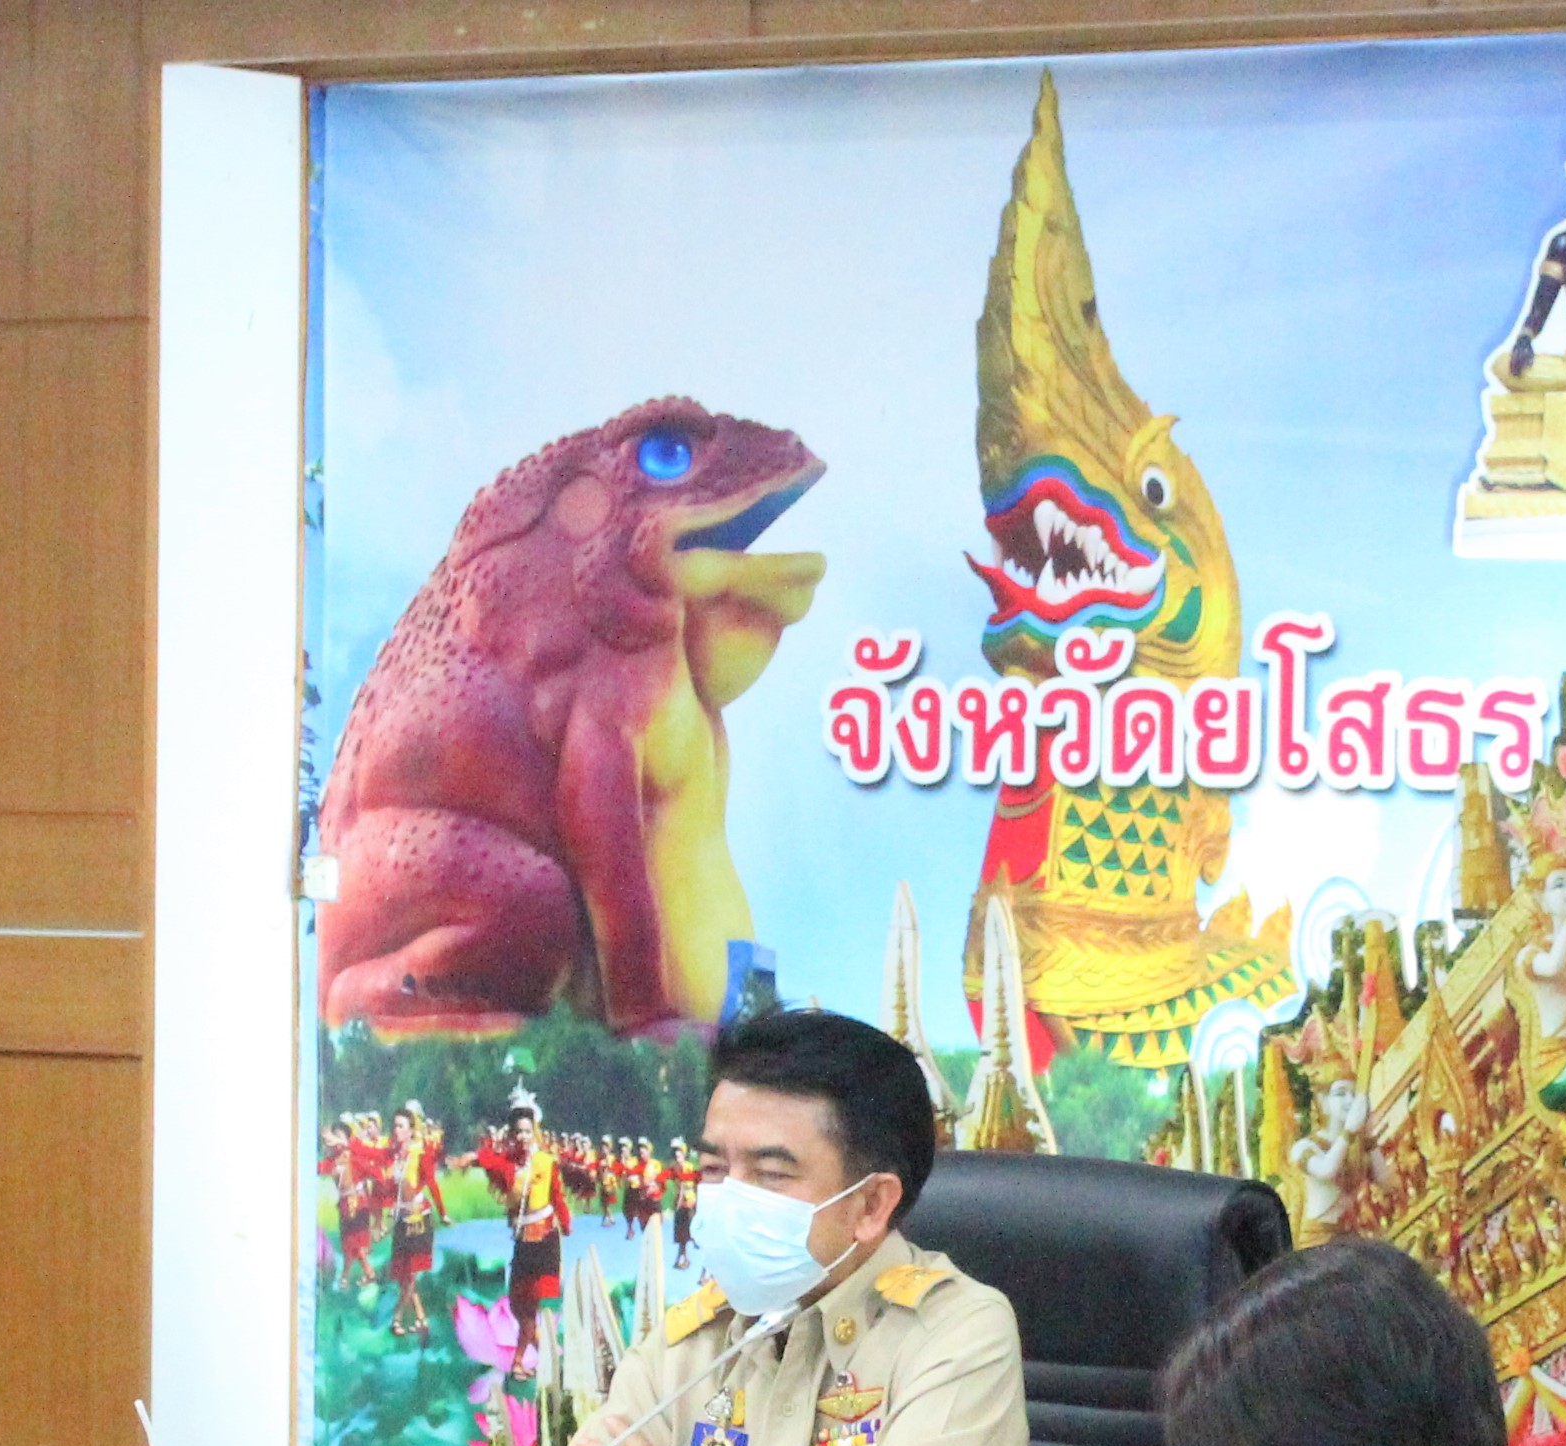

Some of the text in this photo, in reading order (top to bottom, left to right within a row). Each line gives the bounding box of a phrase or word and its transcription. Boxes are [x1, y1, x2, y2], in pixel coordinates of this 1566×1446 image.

[830, 619, 1538, 778] จังหวัดยโสธร
